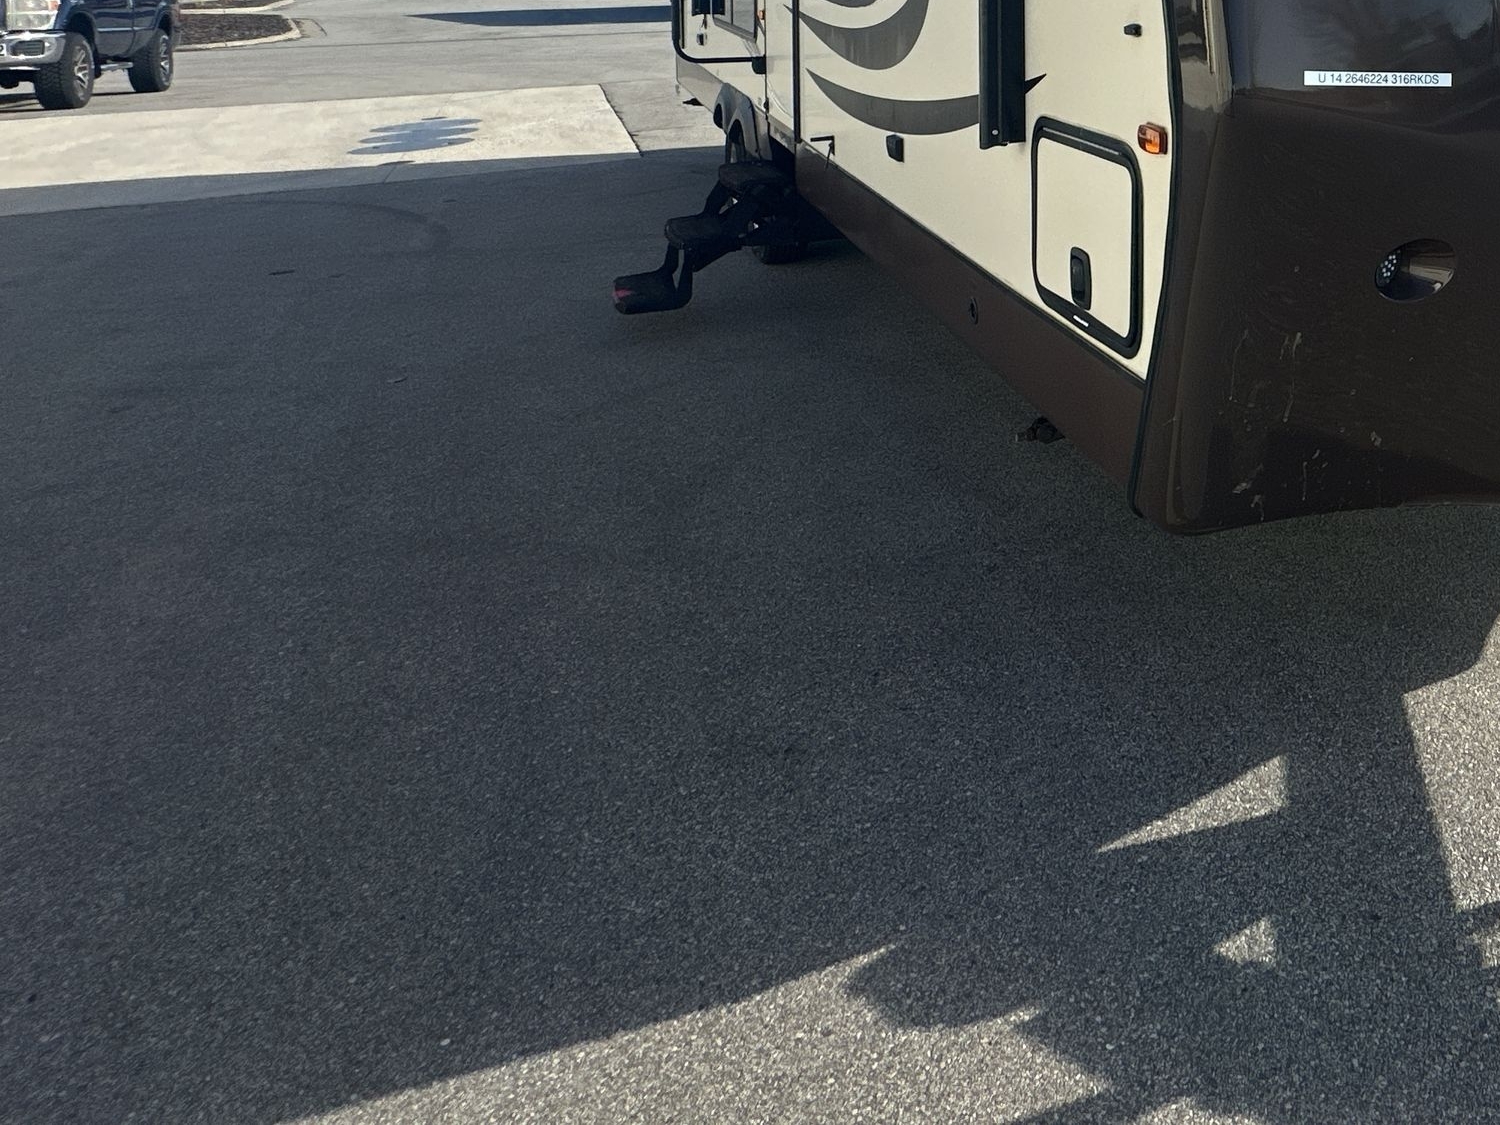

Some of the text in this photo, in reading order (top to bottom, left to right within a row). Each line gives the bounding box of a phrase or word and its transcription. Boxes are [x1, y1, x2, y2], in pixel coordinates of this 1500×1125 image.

[1317, 73, 1440, 85] U 14 2646224 316RKDS
